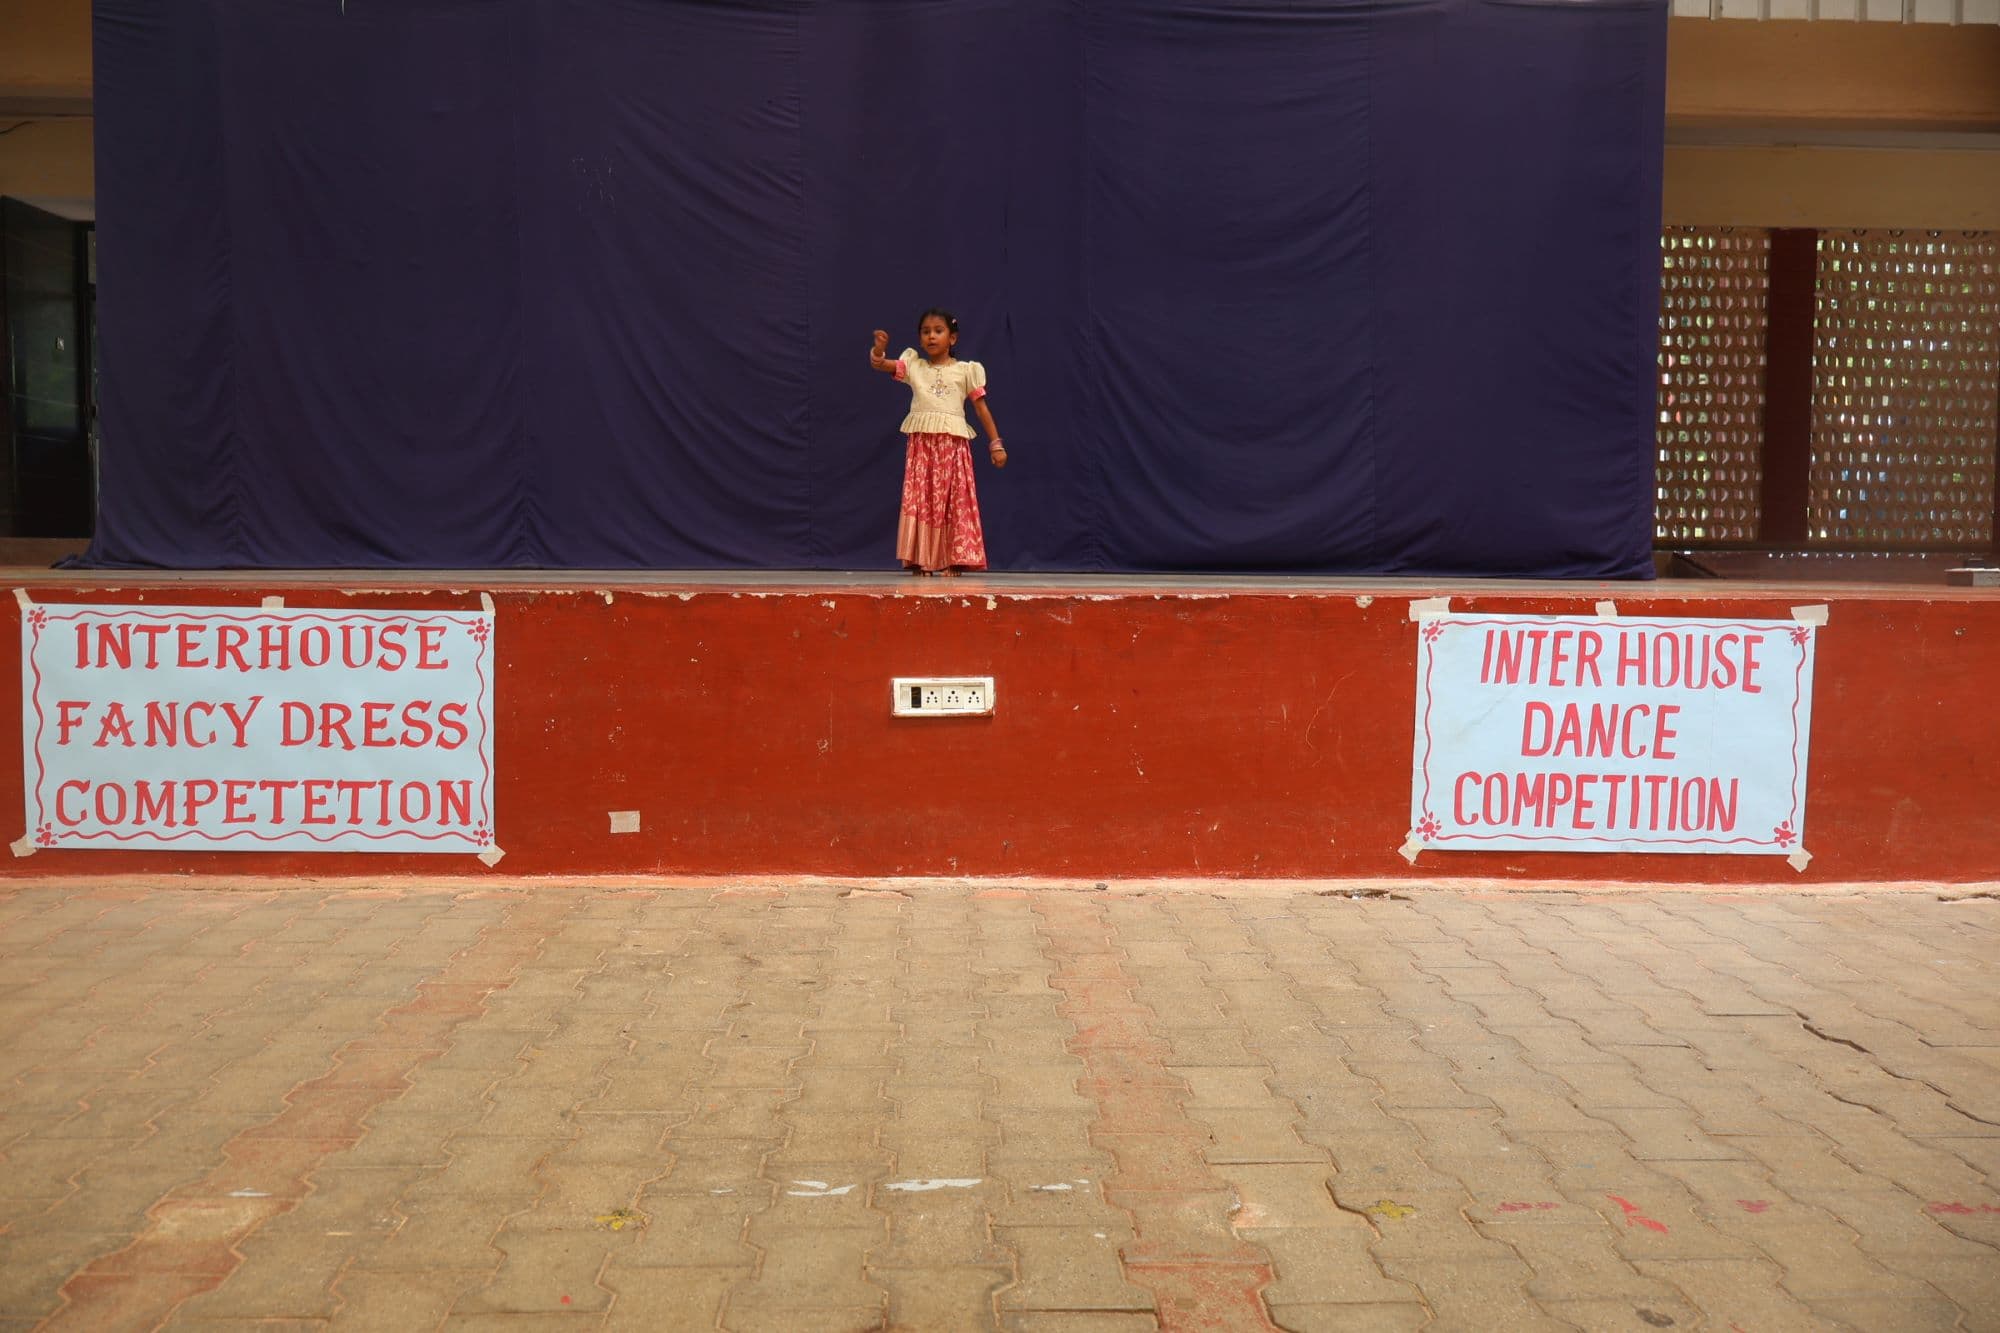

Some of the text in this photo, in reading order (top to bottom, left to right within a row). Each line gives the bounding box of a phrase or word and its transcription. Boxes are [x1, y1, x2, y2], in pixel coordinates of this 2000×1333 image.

[74, 622, 449, 672] INTERHOUSE
[56, 696, 470, 750] FANCY DRESS
[1521, 701, 1681, 760] DANCE
[55, 778, 475, 828] COMPETETION
[1453, 771, 1739, 832] COMPETITION
